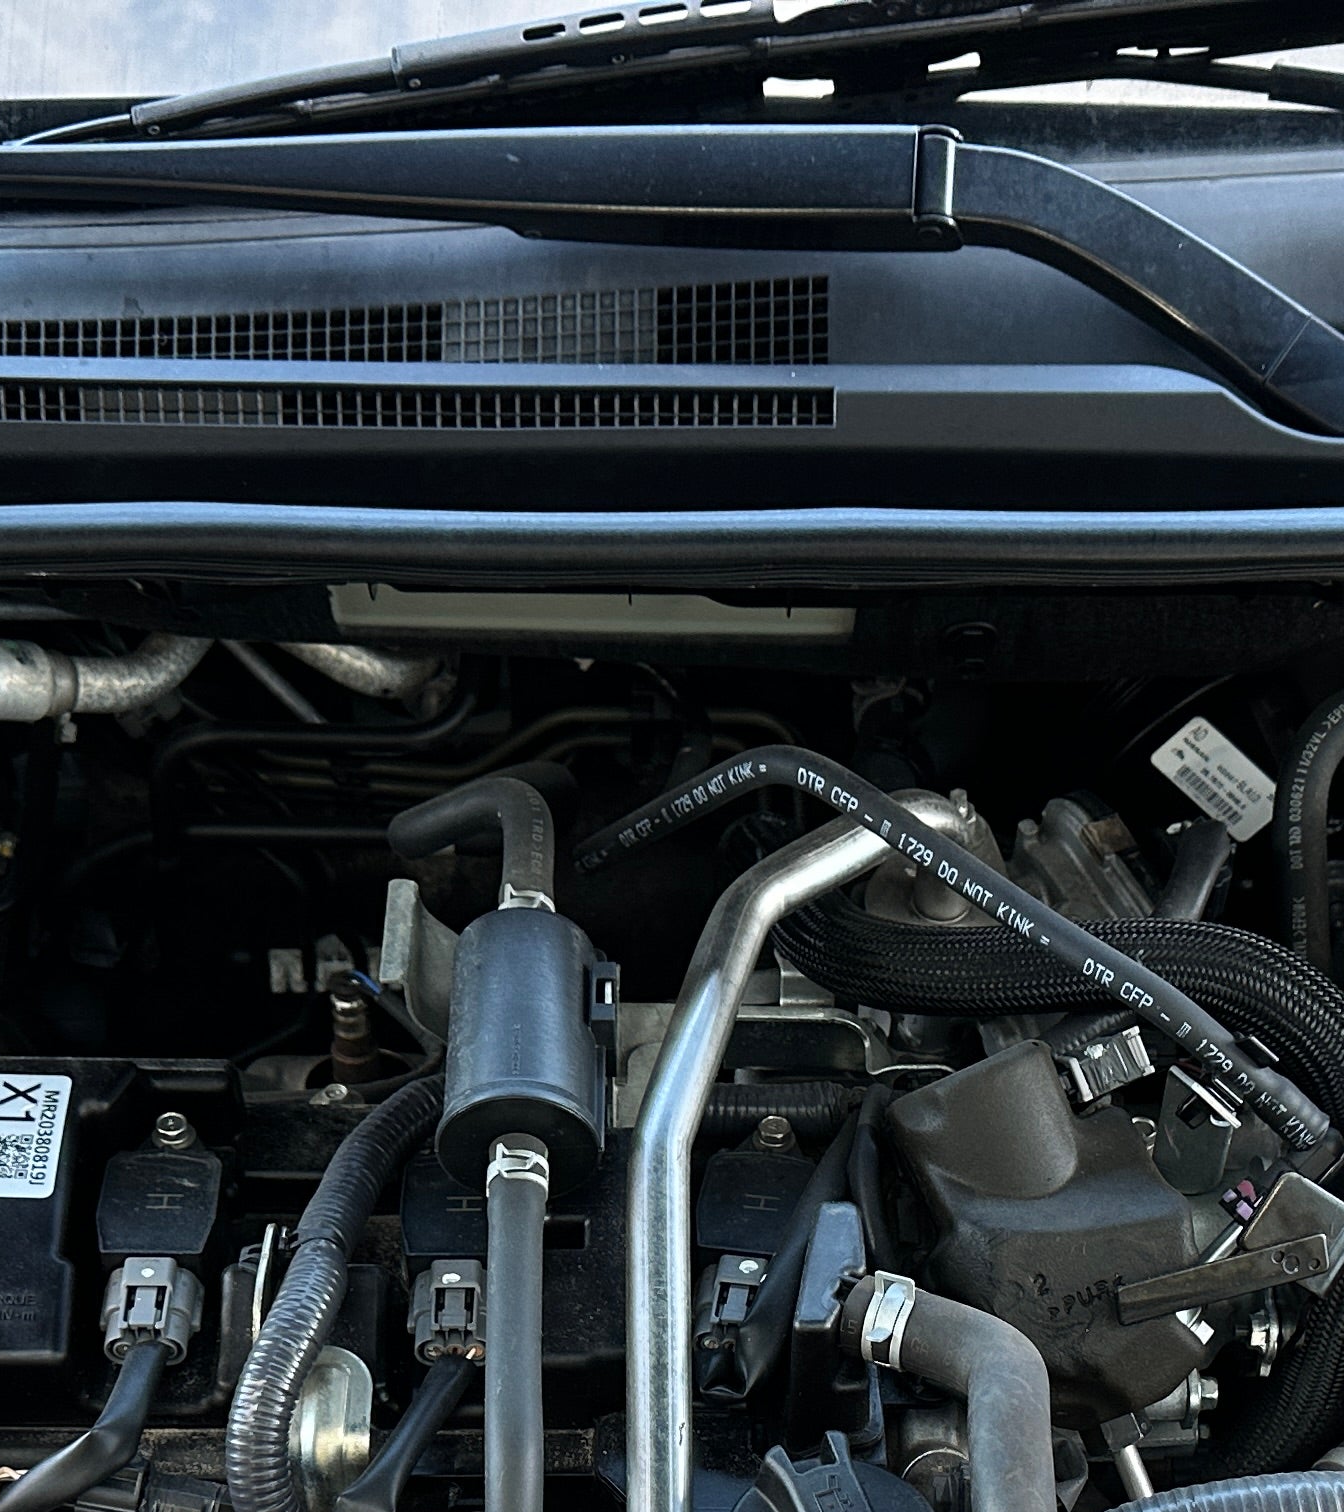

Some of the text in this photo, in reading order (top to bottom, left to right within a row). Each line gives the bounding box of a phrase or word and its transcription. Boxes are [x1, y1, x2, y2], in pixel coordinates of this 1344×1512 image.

[670, 793, 695, 818] 1729
[692, 784, 709, 806] DO
[706, 773, 727, 797] NOT
[728, 761, 756, 786] KINK
[797, 766, 1035, 938] DTR CFP 1729 DO NOT KINK
[1083, 957, 1115, 988] DTR
[1119, 980, 1154, 1009] CFP
[1195, 1037, 1234, 1074] 1729
[28, 1089, 60, 1186] MR20380819J
